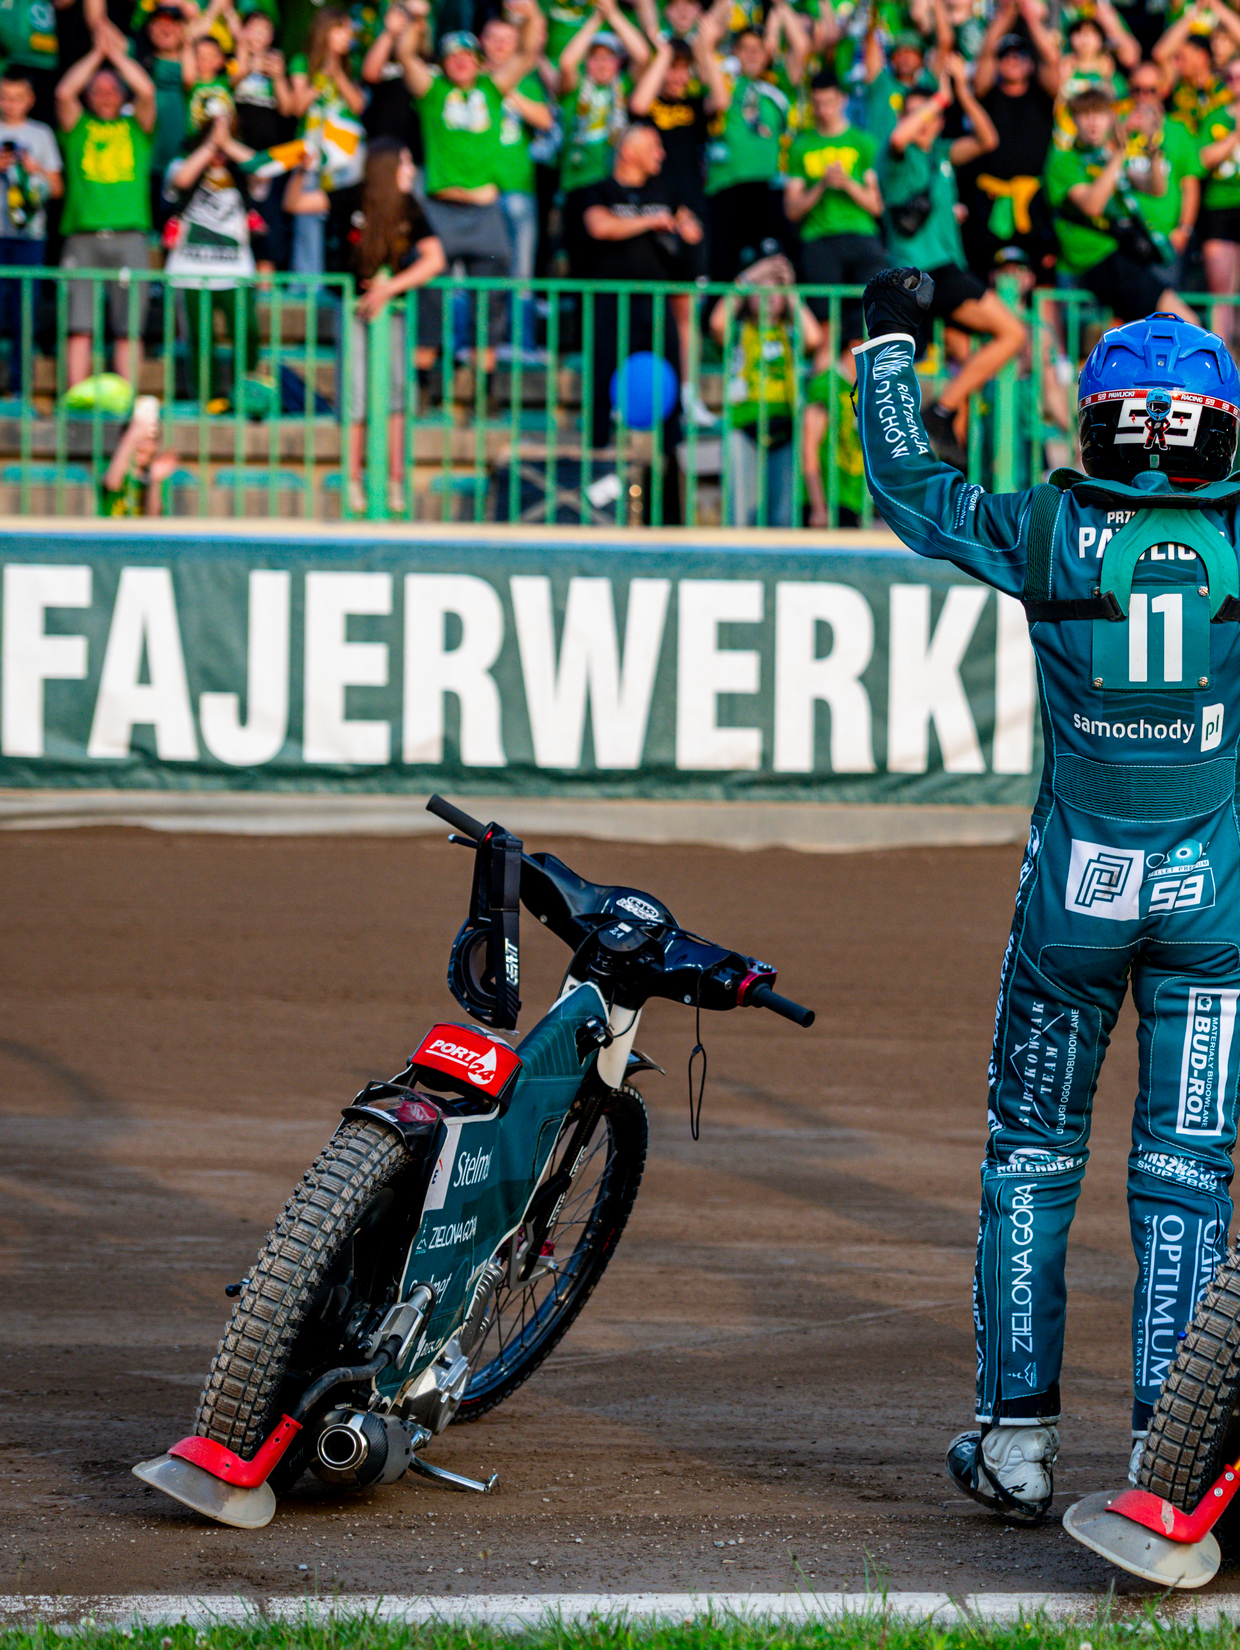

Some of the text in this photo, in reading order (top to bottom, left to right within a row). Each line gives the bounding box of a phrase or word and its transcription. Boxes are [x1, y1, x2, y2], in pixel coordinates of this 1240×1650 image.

[875, 380, 910, 459] DYCHÓW
[1108, 390, 1136, 399] PAWLICKI
[1181, 394, 1203, 404] RACING
[0, 562, 1038, 776] FAJERWERKI
[1073, 711, 1196, 744] samochody
[1148, 874, 1205, 913] 59
[429, 1039, 481, 1062] PORT
[468, 1062, 496, 1081] 24
[1019, 1001, 1045, 1127] BARTKOWIAK
[1040, 1045, 1059, 1095] TEAM
[1060, 1008, 1080, 1103] OGÓLNOBUDOWLANE
[1184, 1015, 1211, 1127] BUD-ROL
[1200, 1017, 1219, 1128] MATERIAŁY BUDOWLANE
[1137, 1160, 1172, 1177] SKUP
[1011, 1183, 1037, 1353] ZIELONA GÓRA
[1141, 1215, 1152, 1294] MASCHINEN
[1148, 1214, 1185, 1387] OPTIMUM
[1135, 1318, 1144, 1386] GERMANY
